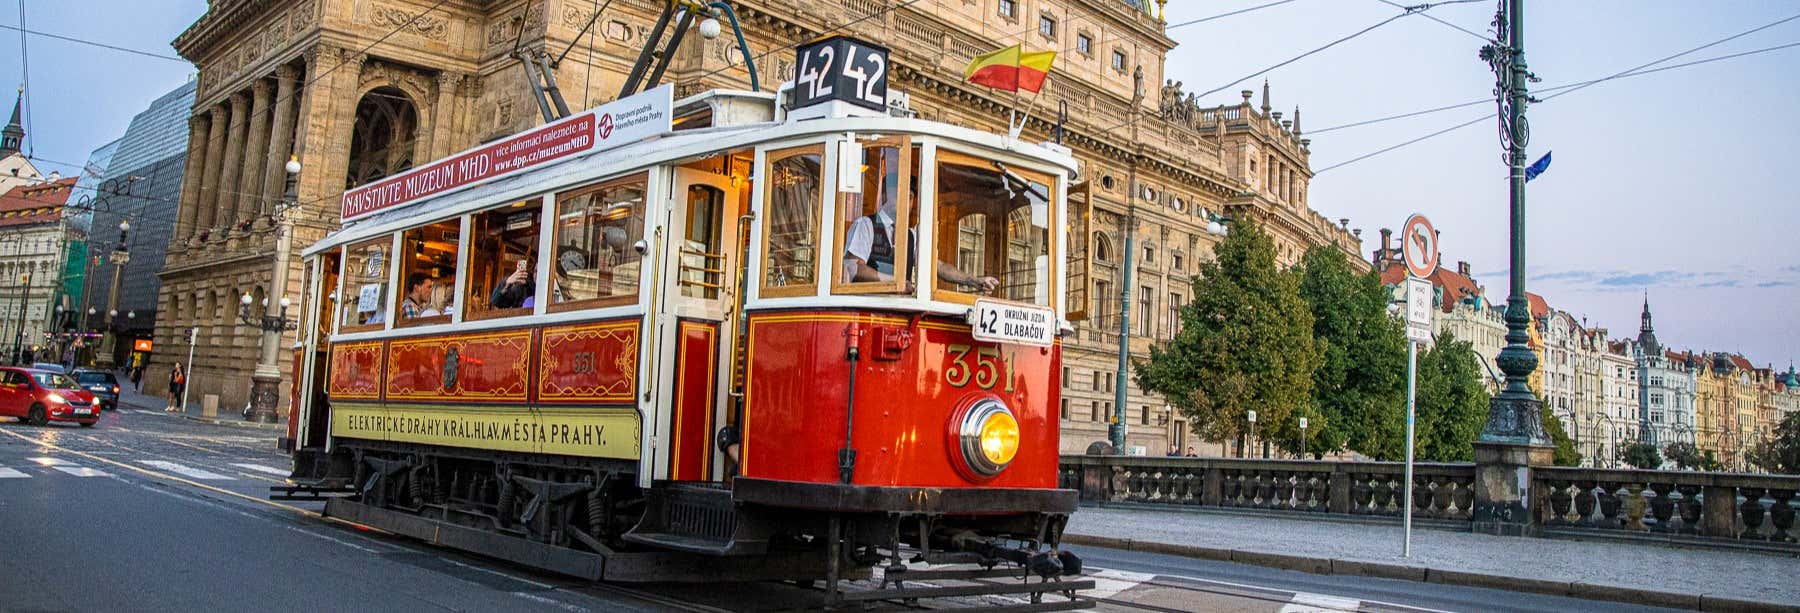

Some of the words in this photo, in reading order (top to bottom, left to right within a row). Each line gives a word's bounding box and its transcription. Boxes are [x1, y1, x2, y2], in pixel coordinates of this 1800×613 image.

[798, 45, 834, 99] 42
[842, 45, 884, 105] 42
[615, 107, 634, 122] Dopravní
[634, 103, 653, 117] podnik
[649, 109, 663, 123] Prahy
[542, 123, 577, 143] naleznete
[578, 120, 588, 133] na
[494, 134, 590, 172] www.dpp.cz/muzeumMHD
[345, 181, 402, 216] NAVŠTIVTE
[405, 163, 455, 200] MUZEUM
[458, 152, 489, 183] MHD
[979, 308, 998, 334] 42
[1004, 308, 1029, 321] OKRUŽNÍ
[1004, 321, 1045, 340] DLABAČOV
[573, 350, 595, 375] 351
[945, 343, 1015, 393] 351
[349, 413, 405, 433] ELEKTRICKÉ
[407, 415, 441, 436] DRÁHY
[551, 423, 607, 446] PRAHY.
